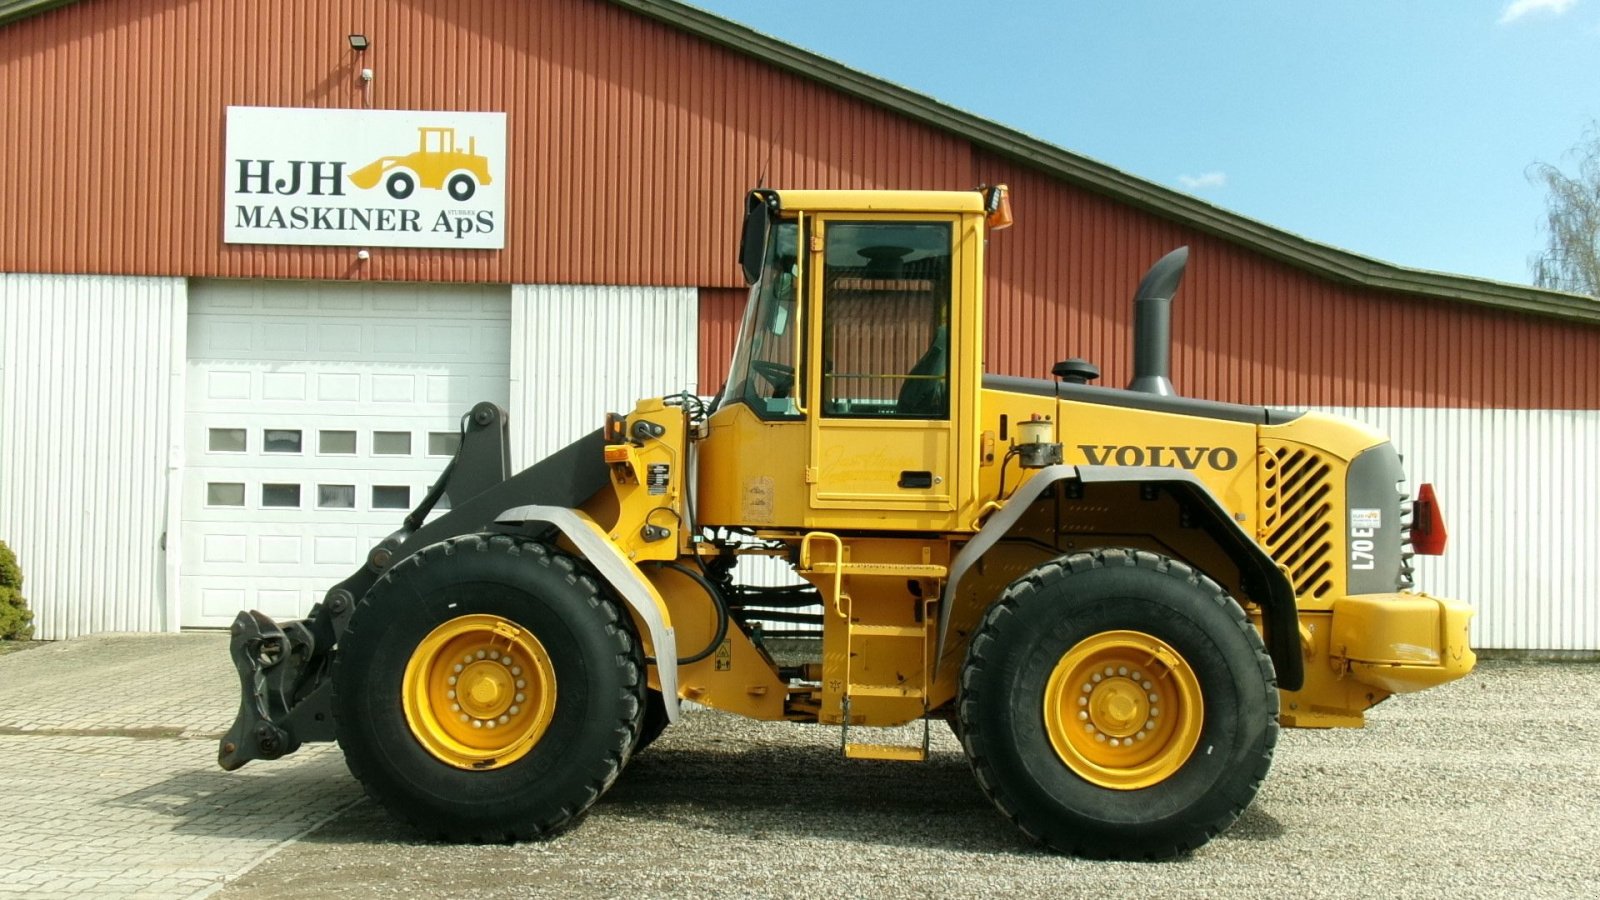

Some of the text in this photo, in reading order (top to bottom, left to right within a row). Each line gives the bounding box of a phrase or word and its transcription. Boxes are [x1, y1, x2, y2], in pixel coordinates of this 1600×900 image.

[235, 159, 347, 196] HJH
[235, 205, 494, 239] MASKINER ApS
[1077, 444, 1238, 471] VOLVO
